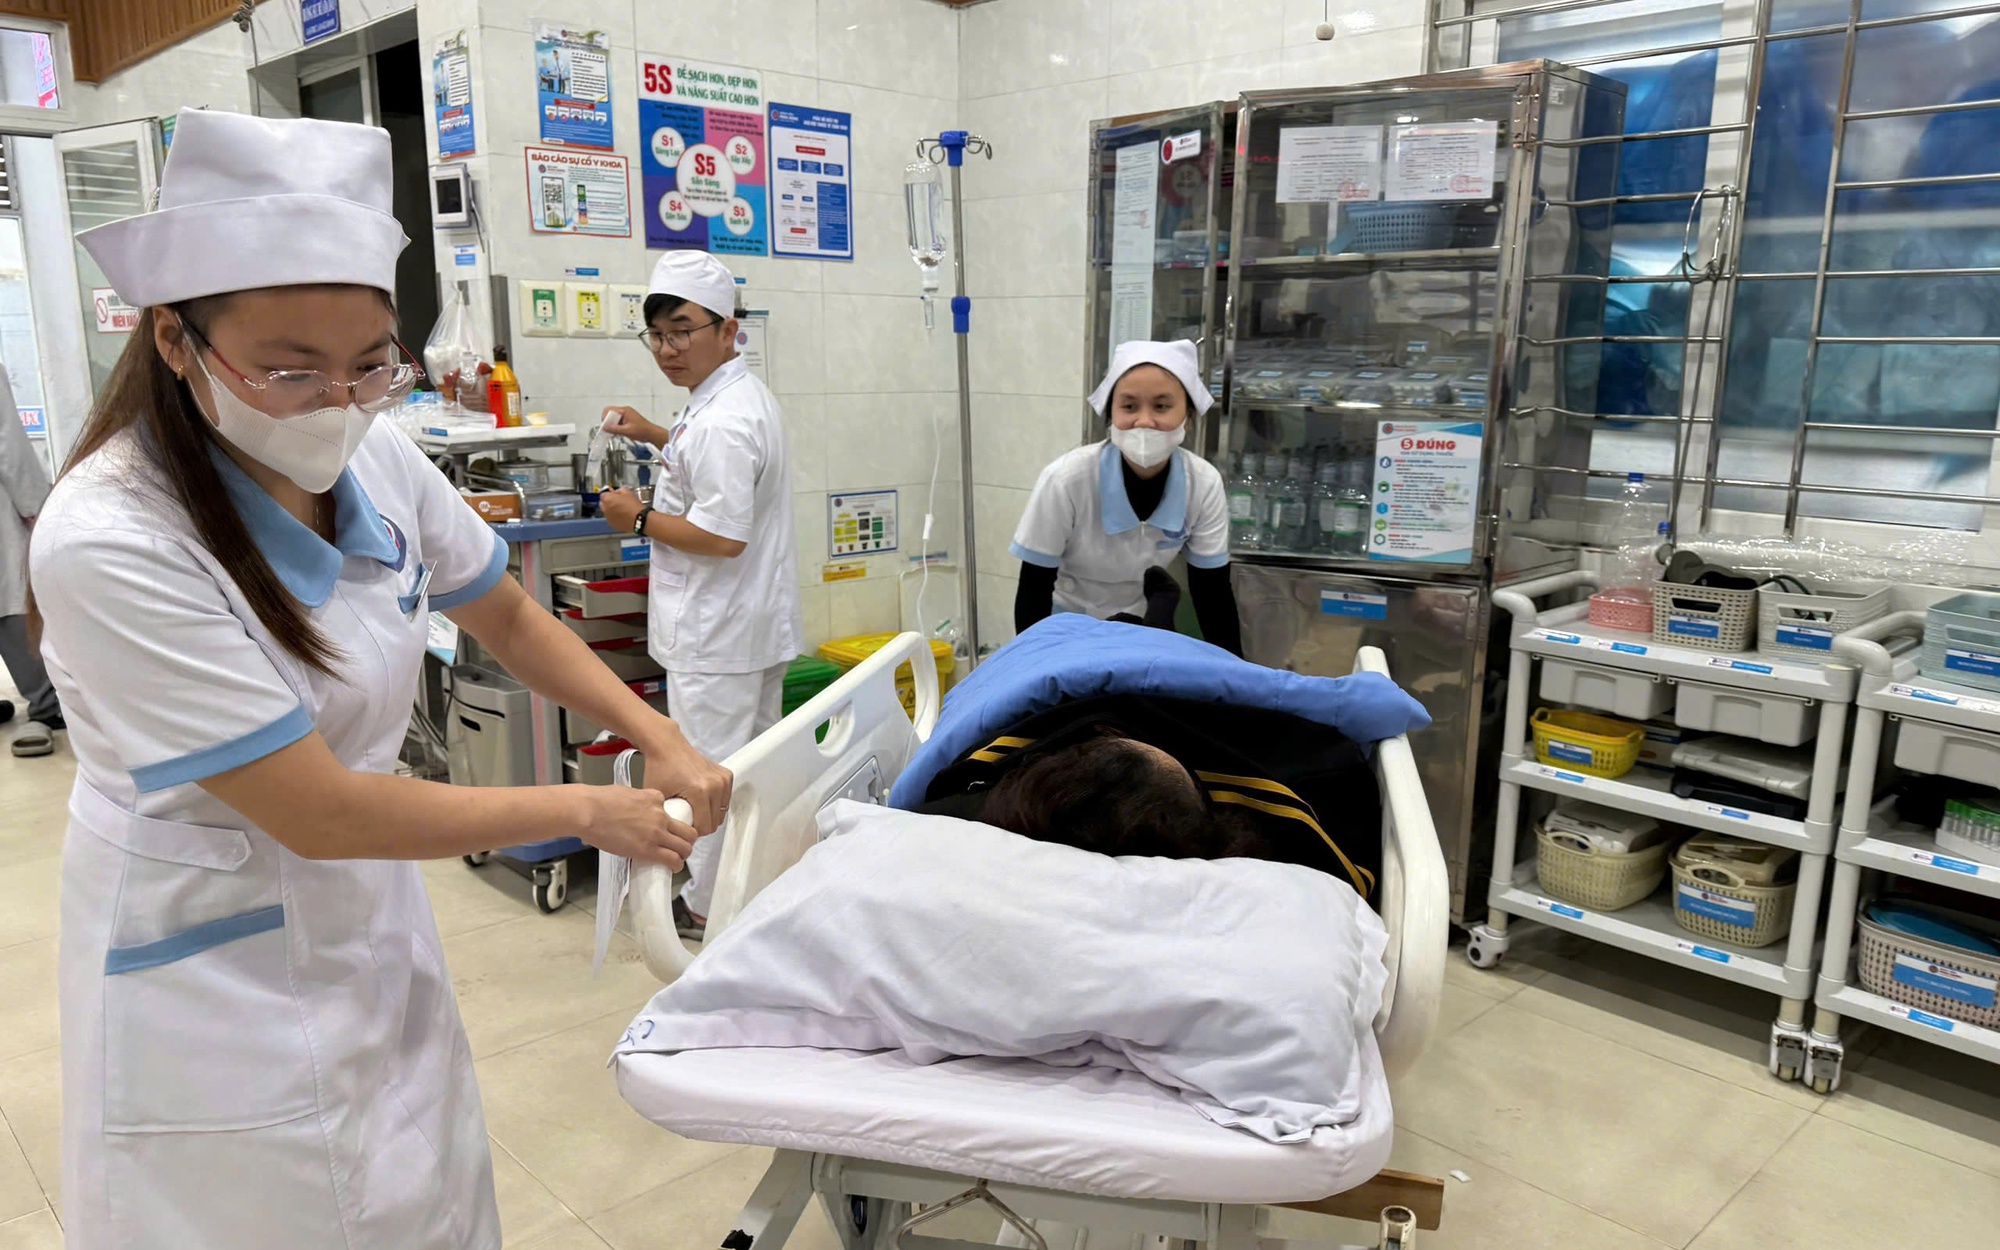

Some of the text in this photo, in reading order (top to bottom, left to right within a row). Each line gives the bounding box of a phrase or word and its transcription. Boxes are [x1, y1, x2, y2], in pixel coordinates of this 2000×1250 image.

[644, 63, 672, 94] 5S
[688, 69, 707, 83] SẠCH
[743, 77, 757, 89] HƠN
[676, 82, 686, 96] VÀ
[688, 85, 708, 100] NĂNG
[729, 93, 743, 103] CAO
[745, 94, 759, 106] HƠN
[662, 134, 673, 147] S1
[735, 144, 747, 155] S2
[531, 152, 549, 162] BÁO
[551, 153, 567, 163] CÁO
[695, 153, 716, 176] S5
[669, 200, 682, 211] S4
[733, 205, 745, 217] S3
[1416, 437, 1456, 450] ĐÚNG
